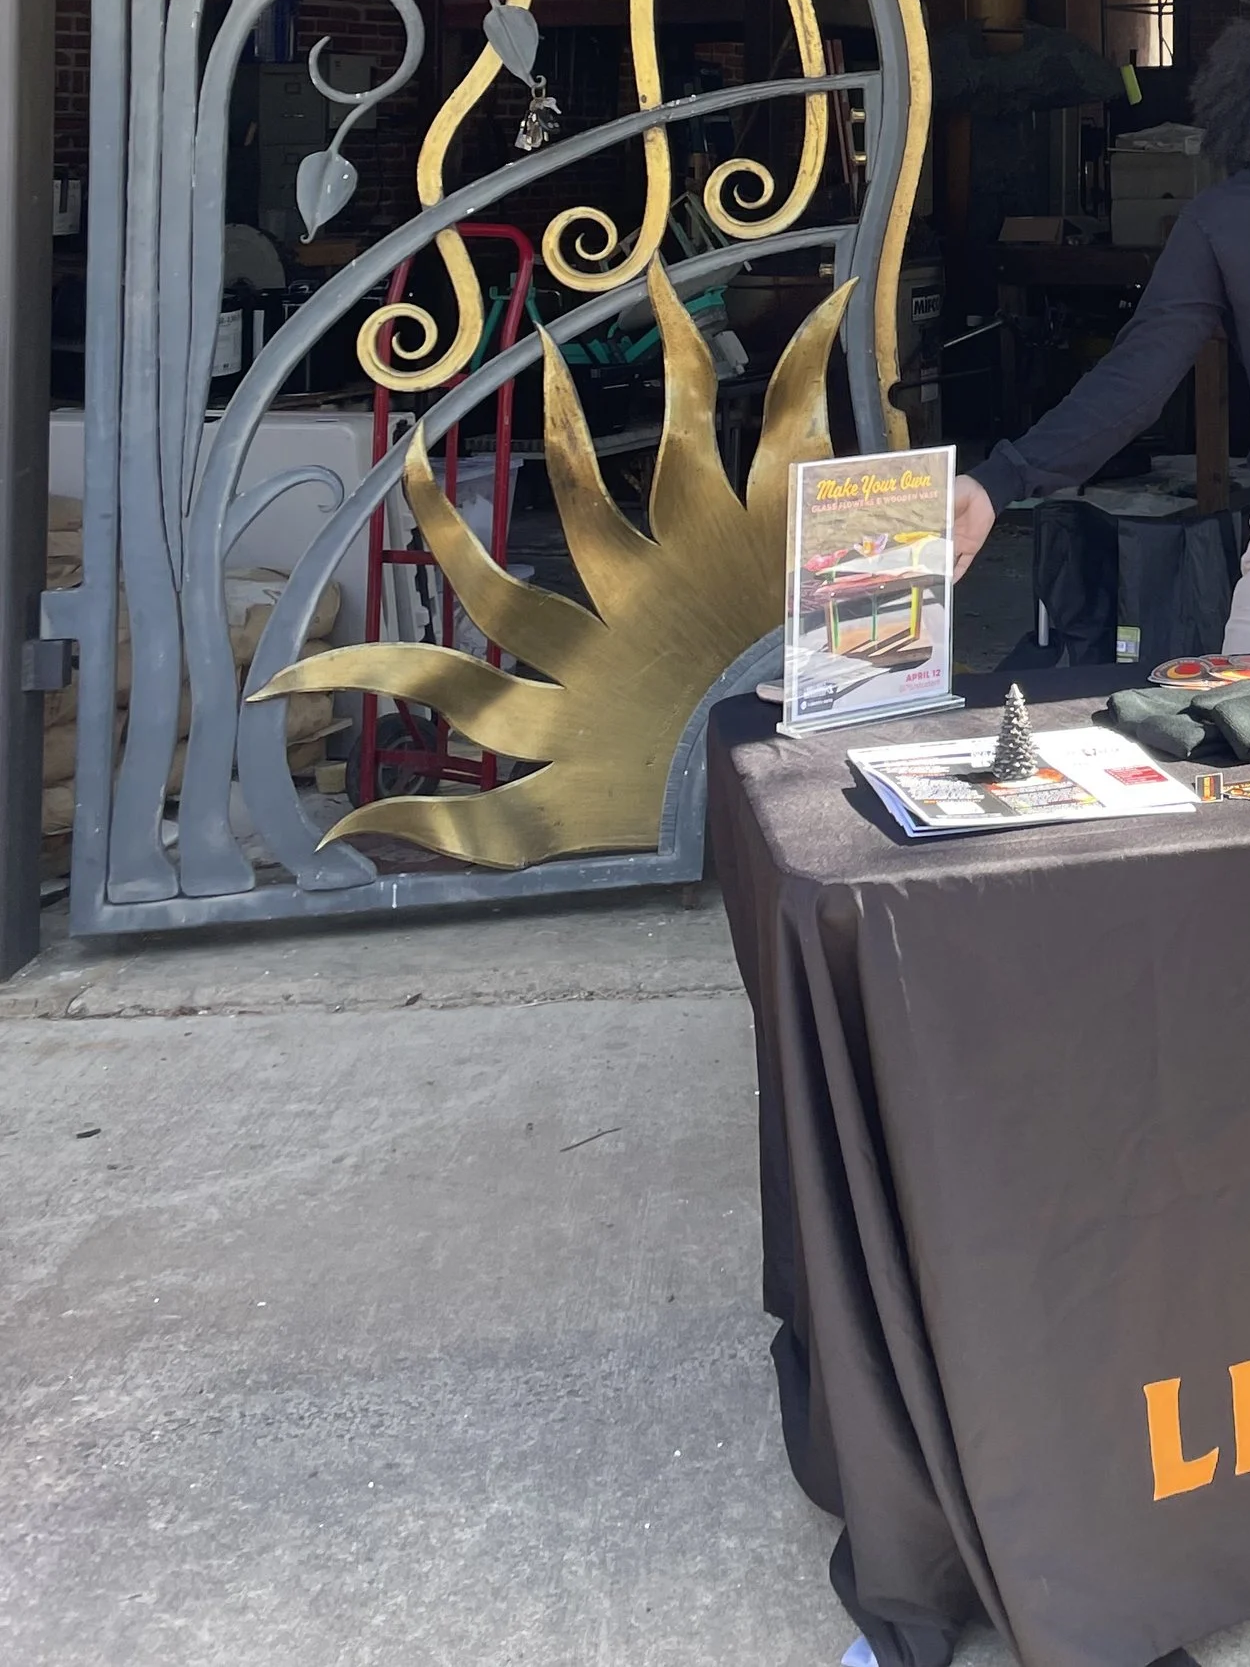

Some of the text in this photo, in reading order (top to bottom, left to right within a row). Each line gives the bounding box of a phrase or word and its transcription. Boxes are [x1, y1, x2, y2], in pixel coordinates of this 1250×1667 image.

[816, 470, 932, 502] Make Your Own
[811, 502, 837, 513] GLASS
[905, 669, 941, 683] APRIL 12
